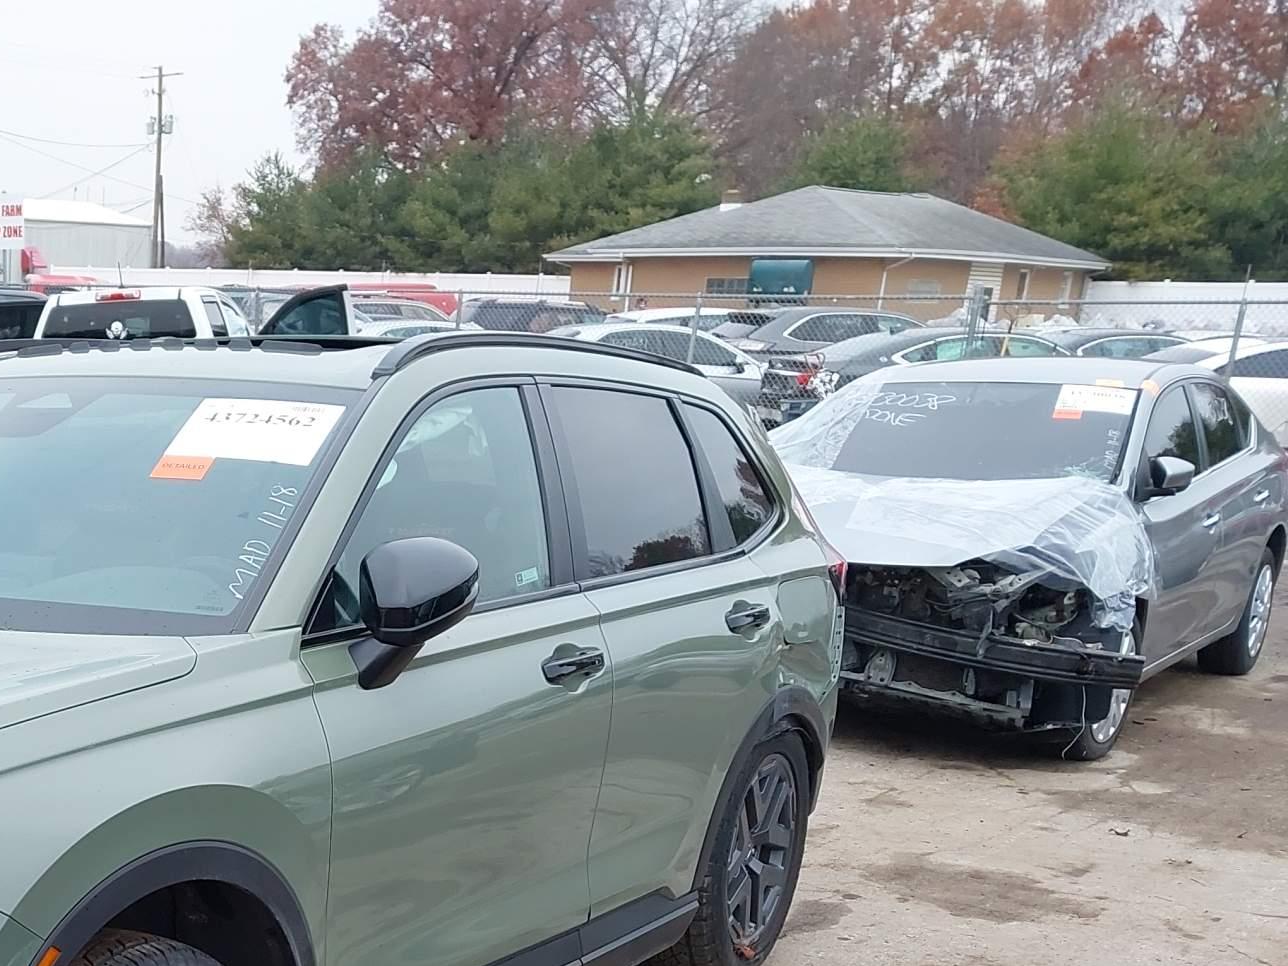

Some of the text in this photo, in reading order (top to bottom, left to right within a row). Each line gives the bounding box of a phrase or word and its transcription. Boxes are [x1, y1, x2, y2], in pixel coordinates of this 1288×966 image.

[1, 204, 23, 217] FARM
[3, 225, 23, 238] ZONE
[204, 411, 316, 427] 43724562
[162, 462, 206, 470] DETAILED
[228, 483, 298, 600] MAD 11-18
